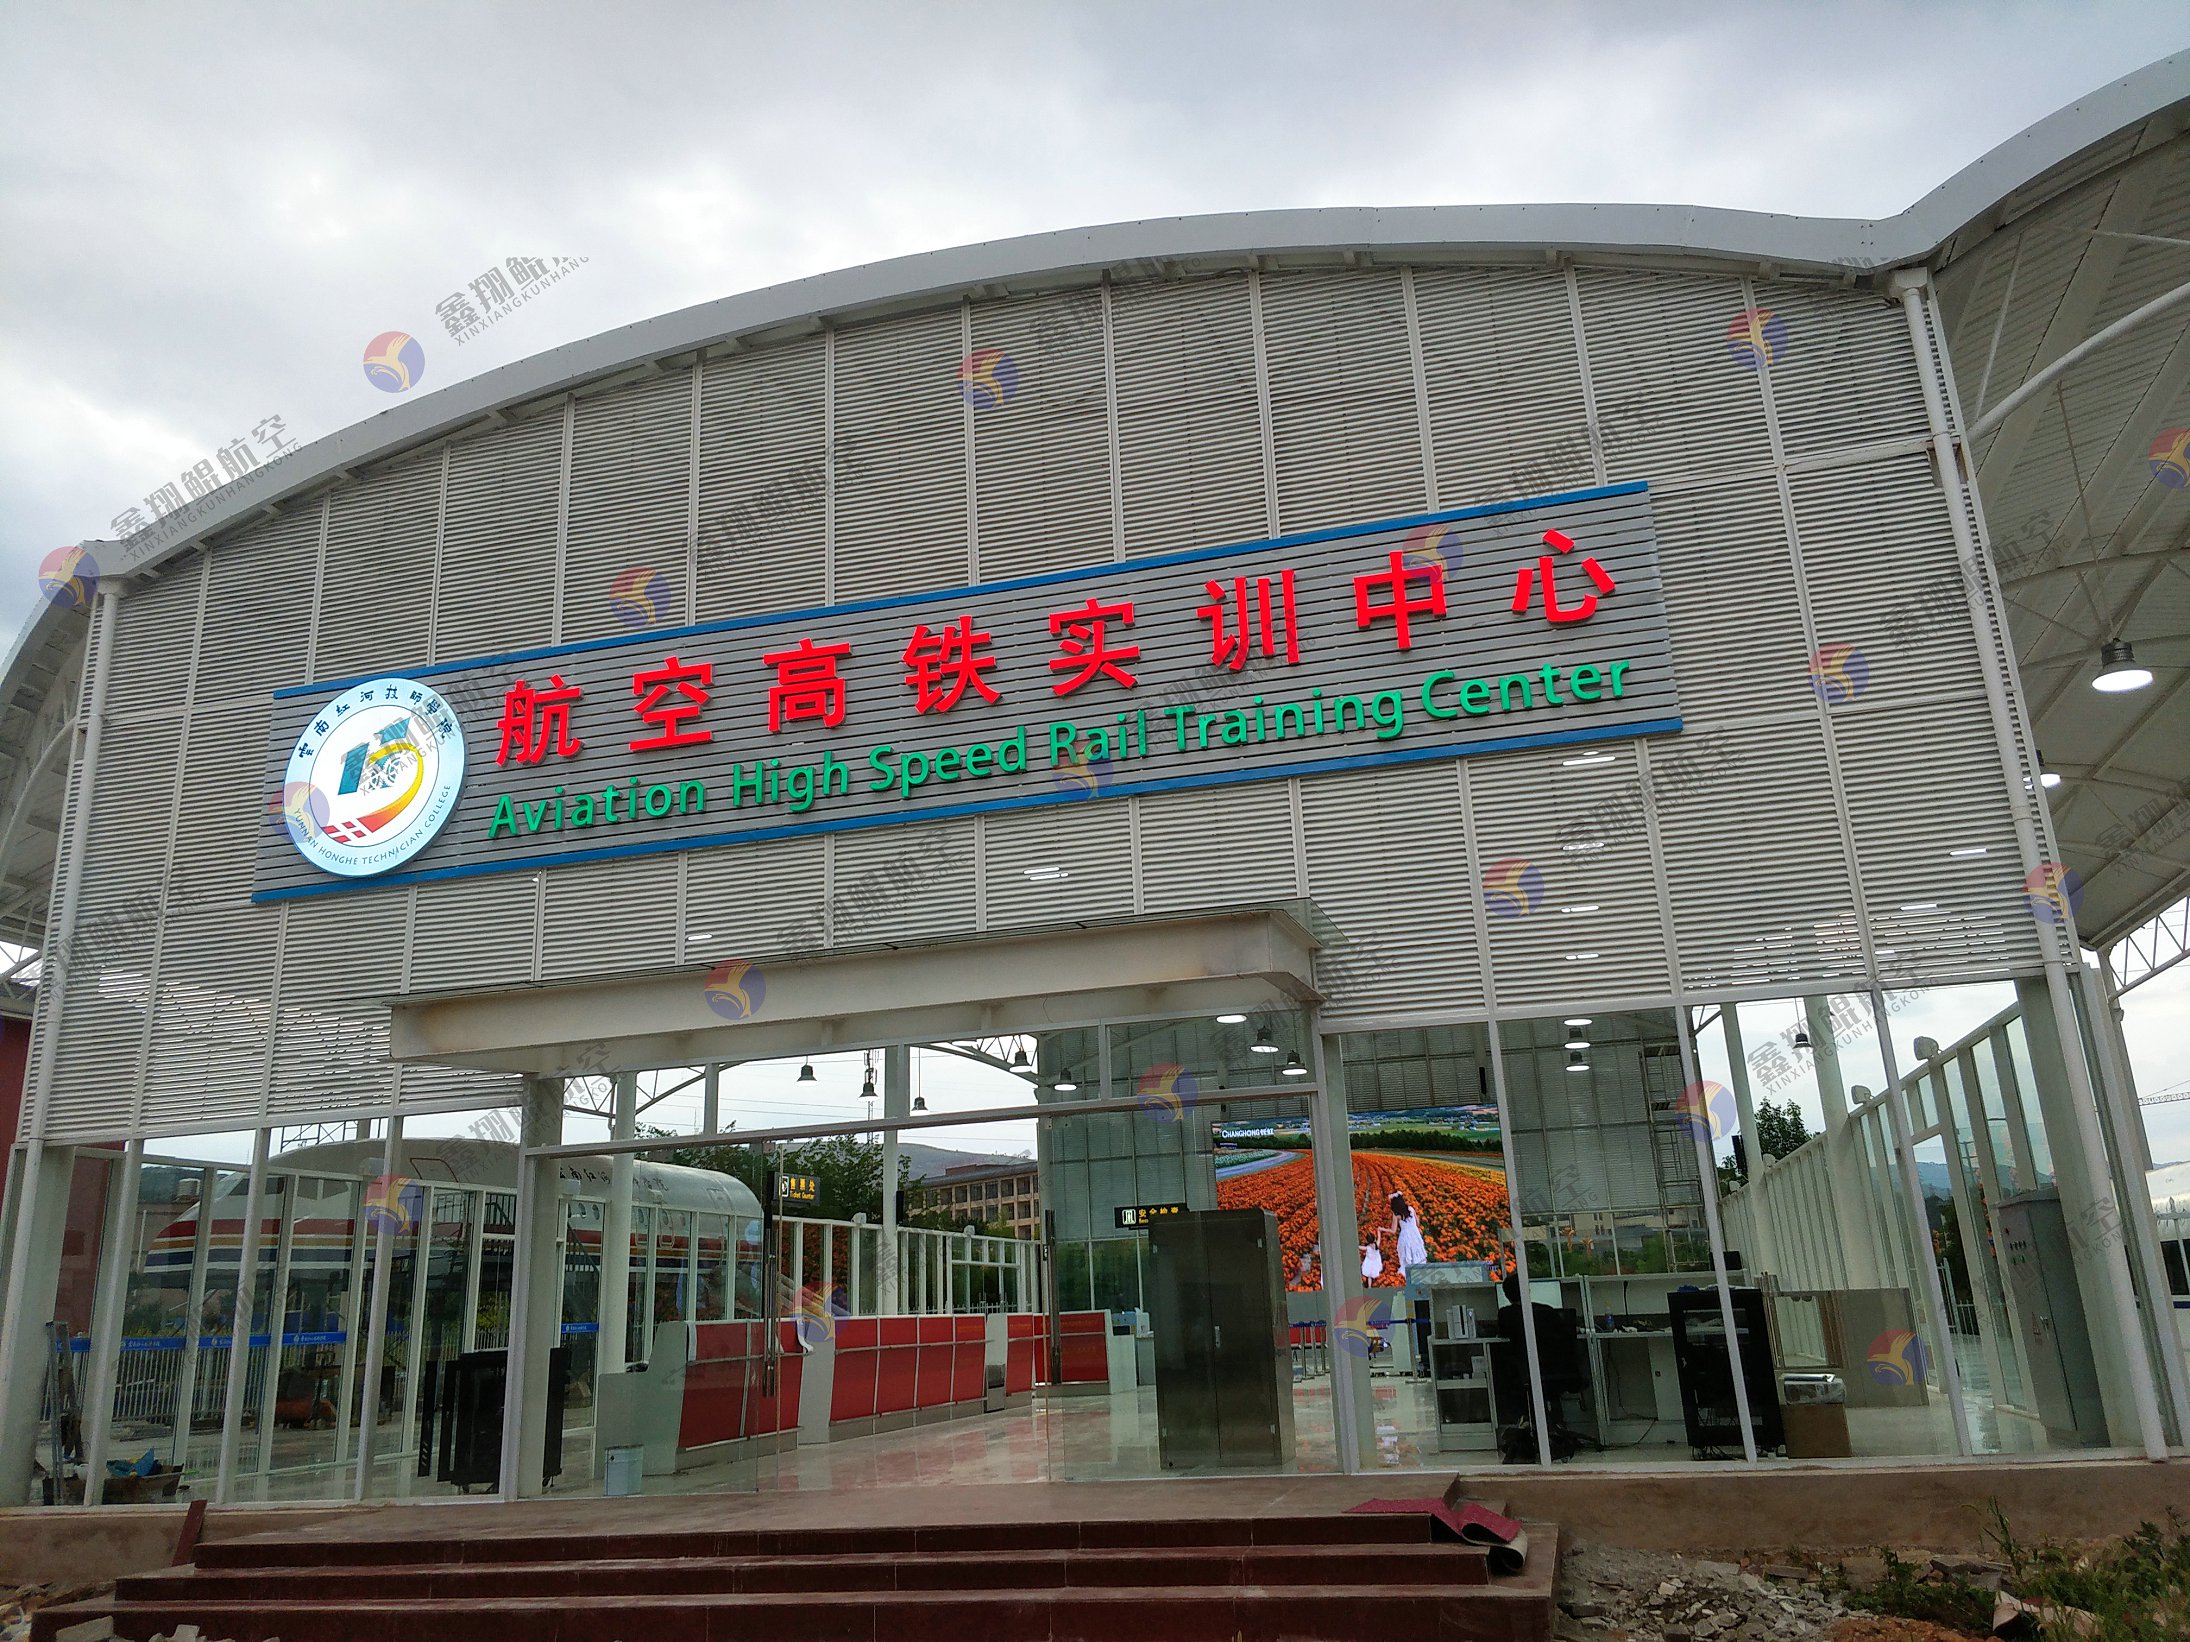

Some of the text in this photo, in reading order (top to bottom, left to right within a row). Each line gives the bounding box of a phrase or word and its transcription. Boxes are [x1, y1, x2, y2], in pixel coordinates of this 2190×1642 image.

[495, 529, 1617, 768] 航空高铁实训中心
[294, 785, 451, 865] YUNNAN HONGHE TECHNICIAN COLLEGE
[489, 660, 1631, 838] Aviation High Speed Rail Training Center
